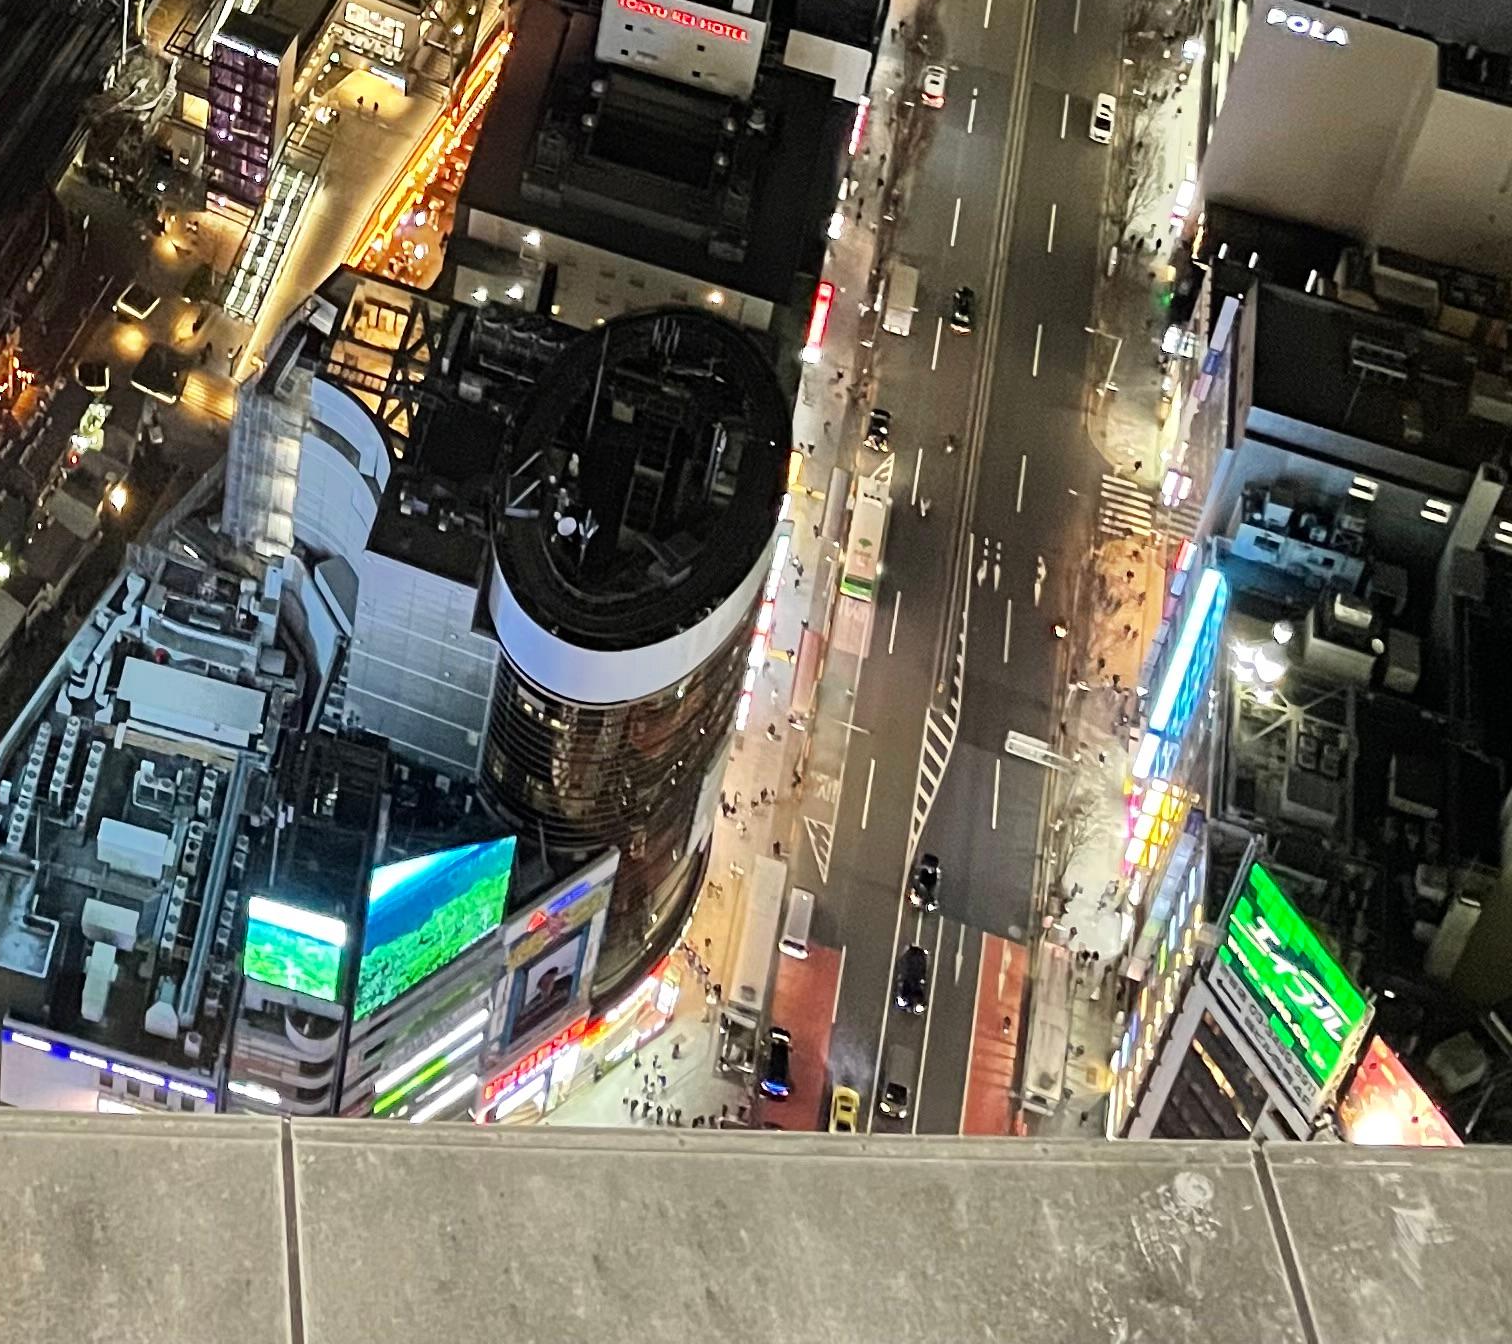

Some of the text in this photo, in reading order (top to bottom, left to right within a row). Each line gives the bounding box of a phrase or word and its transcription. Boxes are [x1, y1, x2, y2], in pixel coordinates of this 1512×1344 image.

[671, 10, 696, 26] REI
[699, 17, 750, 42] HOTEL
[1267, 8, 1349, 46] POLA
[1230, 913, 1352, 1044] エイブル
